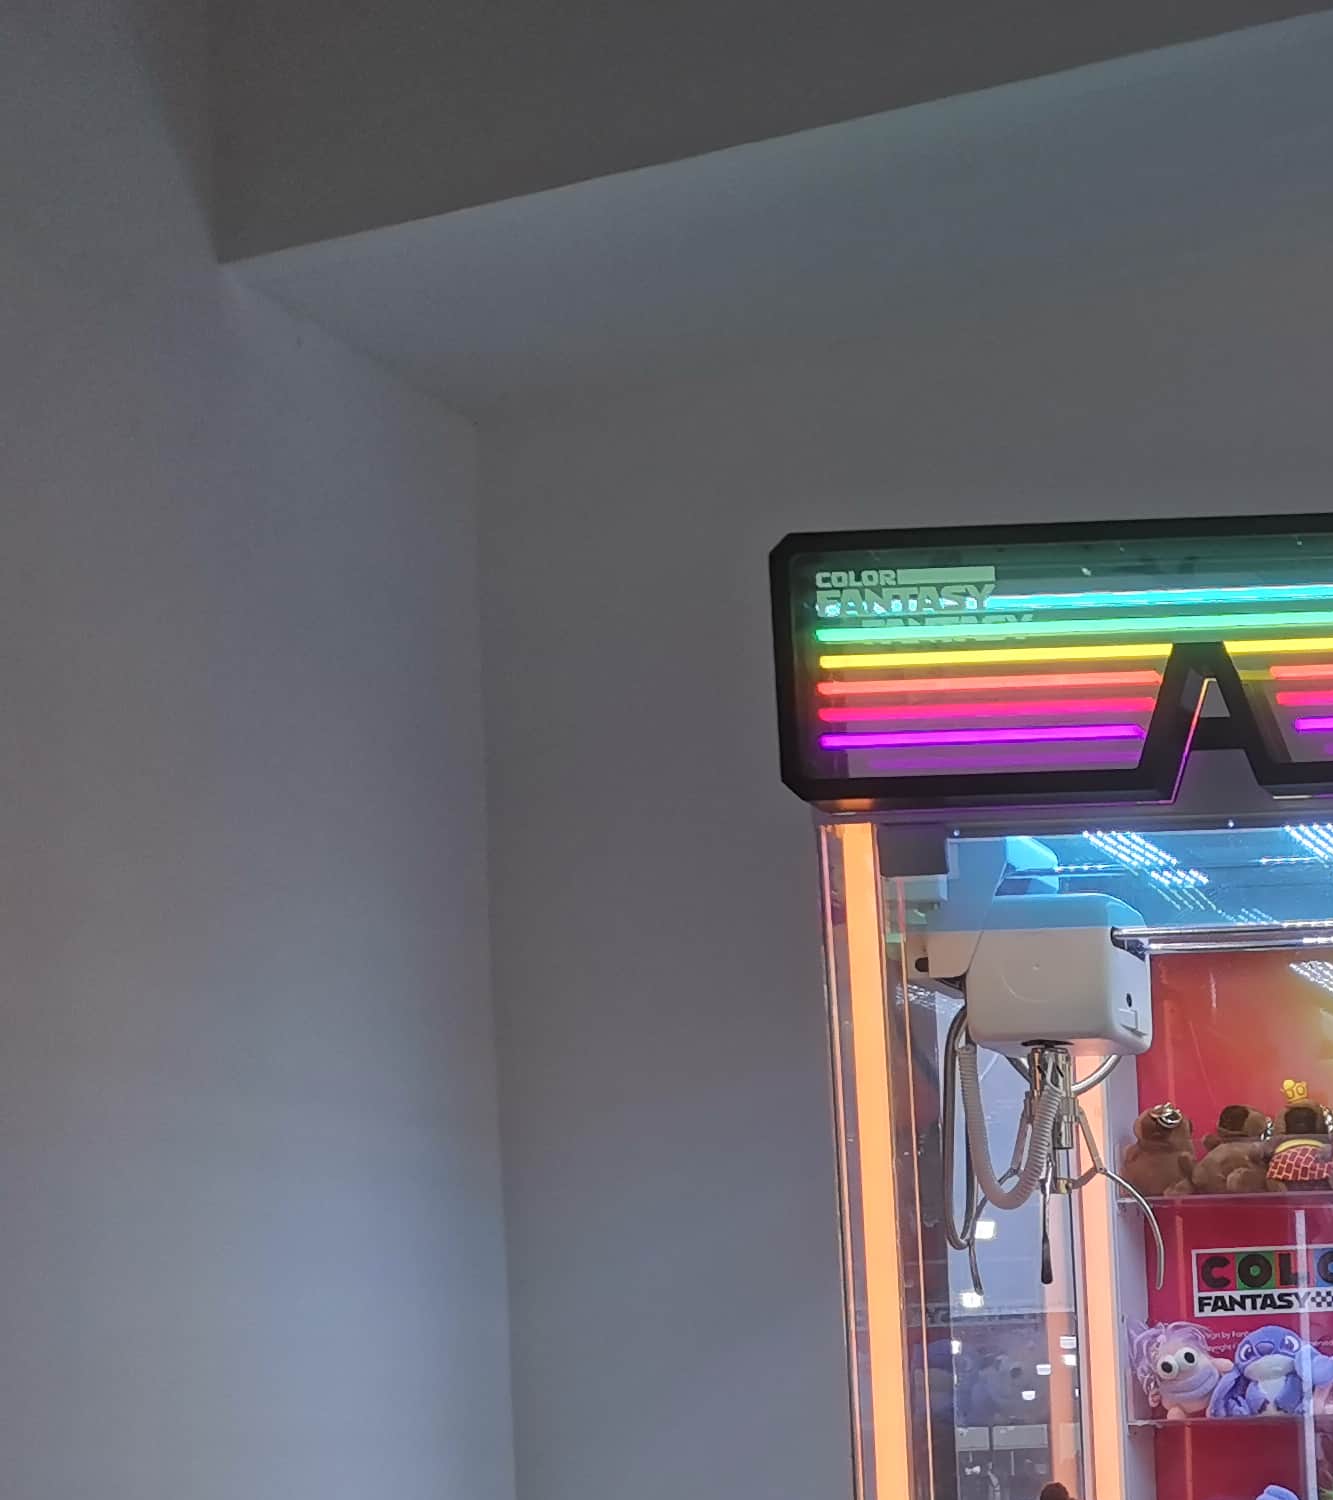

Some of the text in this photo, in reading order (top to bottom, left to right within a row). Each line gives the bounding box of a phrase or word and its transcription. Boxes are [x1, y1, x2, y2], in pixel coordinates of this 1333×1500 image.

[815, 569, 898, 588] COLOR
[816, 584, 996, 618] FANTASY
[1198, 1291, 1311, 1314] FANTASY
